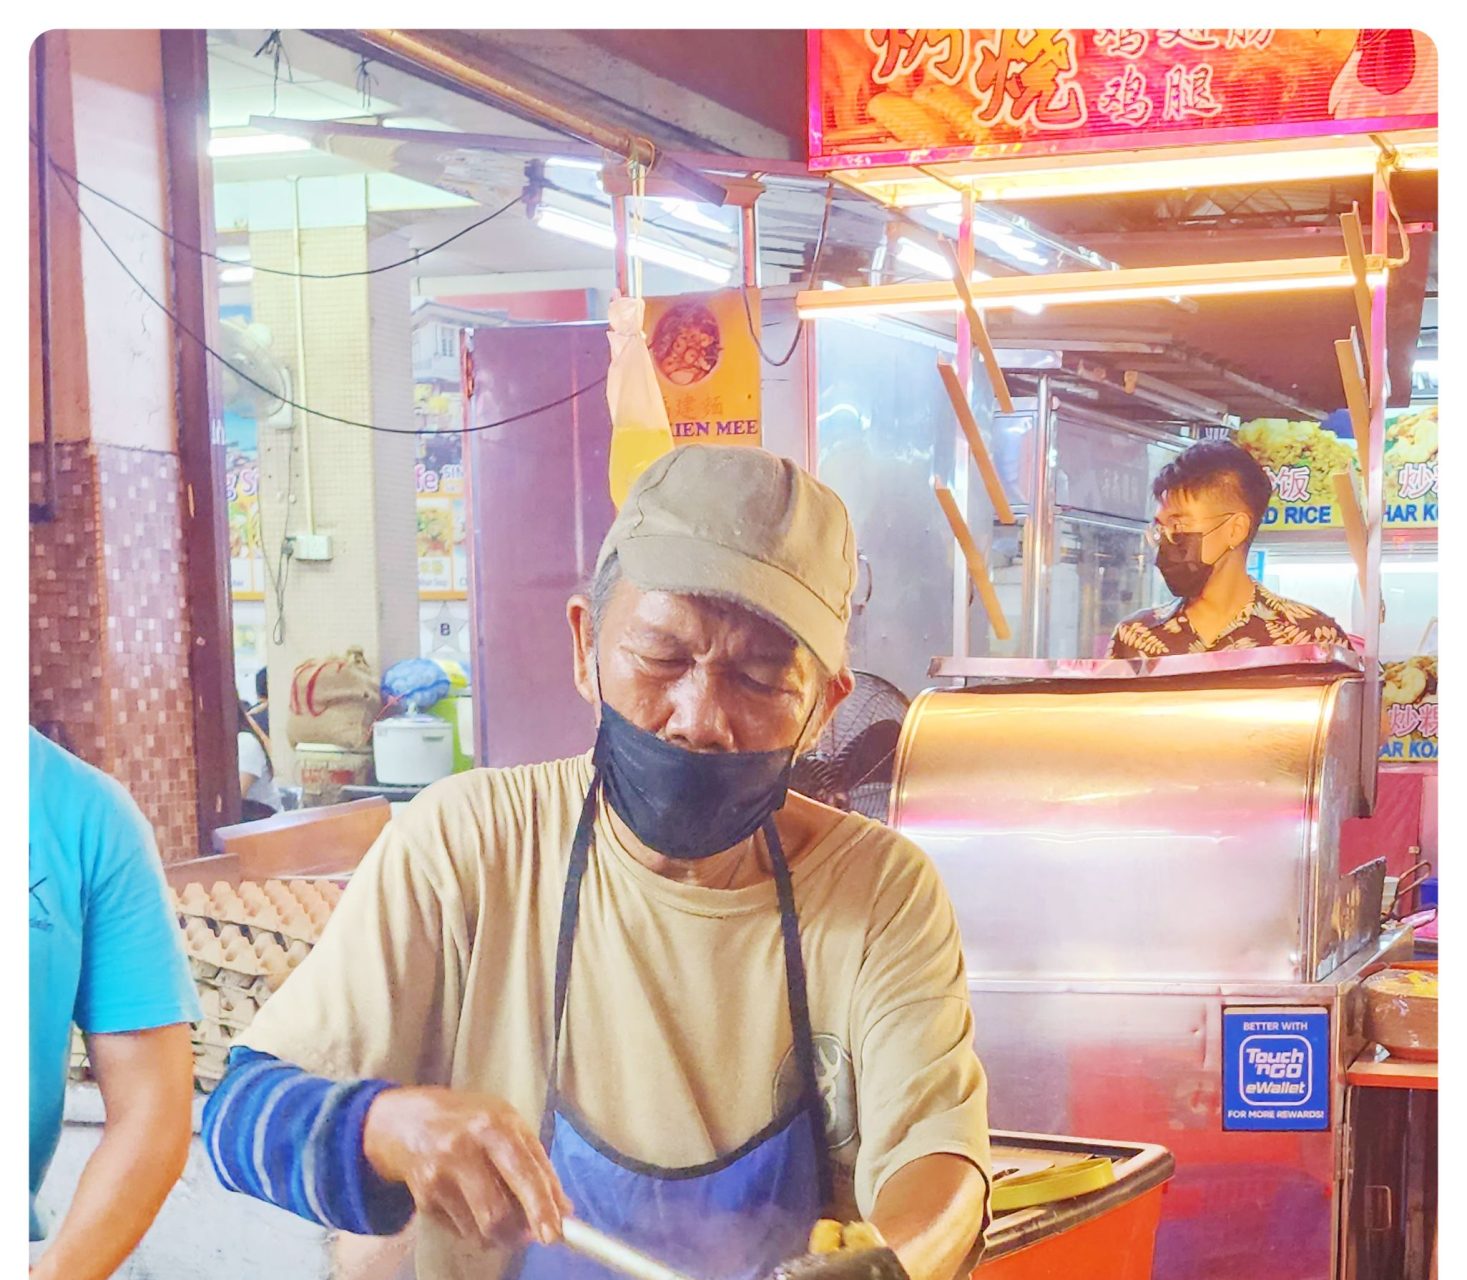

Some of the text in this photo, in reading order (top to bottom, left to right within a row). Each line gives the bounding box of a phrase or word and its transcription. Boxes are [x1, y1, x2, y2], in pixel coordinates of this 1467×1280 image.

[716, 420, 758, 436] MEE
[1285, 505, 1331, 524] RICE
[1423, 504, 1438, 521] K
[1243, 1021, 1308, 1031] BETTER WITH
[1246, 1048, 1305, 1064] Touch
[1246, 1081, 1306, 1094] eWallet
[1227, 1110, 1324, 1119] FOR MORE REWARDS!
